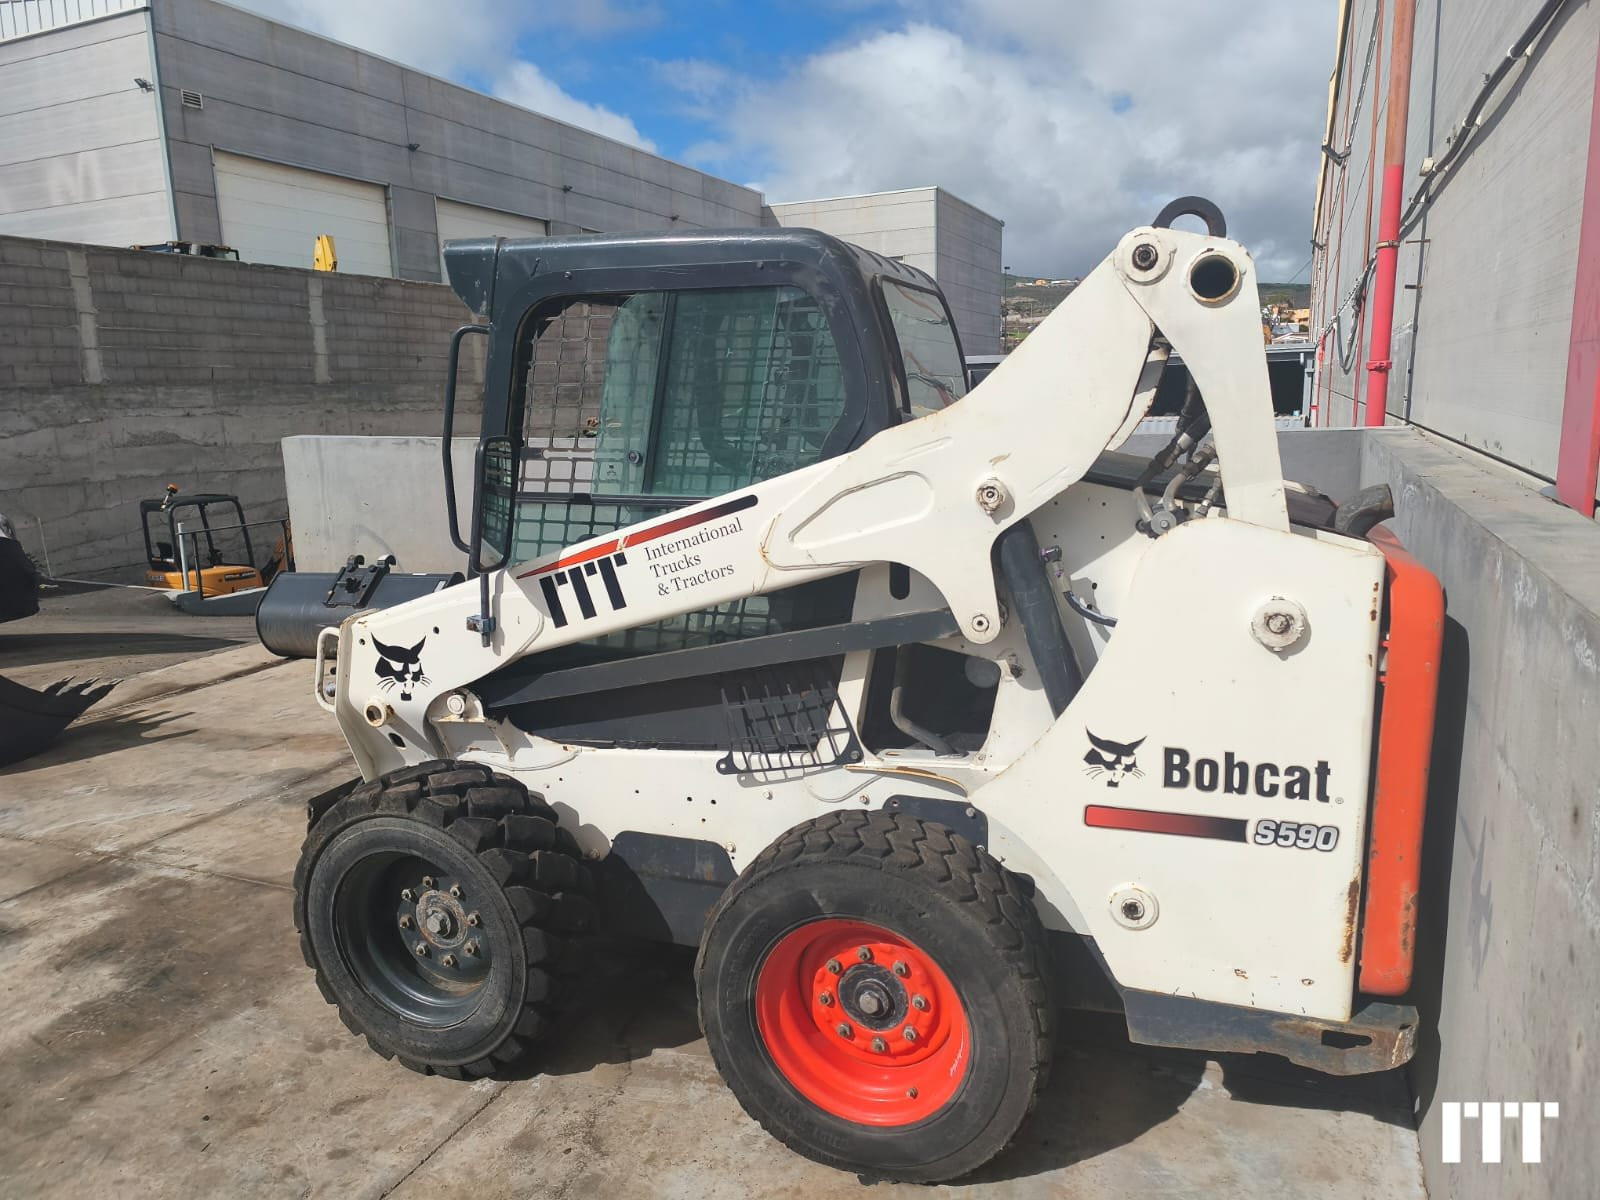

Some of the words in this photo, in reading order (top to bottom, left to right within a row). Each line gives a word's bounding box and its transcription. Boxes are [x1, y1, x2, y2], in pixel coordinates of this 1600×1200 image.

[643, 516, 744, 561] International
[649, 554, 702, 578] Trucks
[658, 583, 670, 596] &
[670, 564, 735, 592] Tractors
[1163, 746, 1331, 803] Bobcat
[1253, 819, 1339, 852] S590
